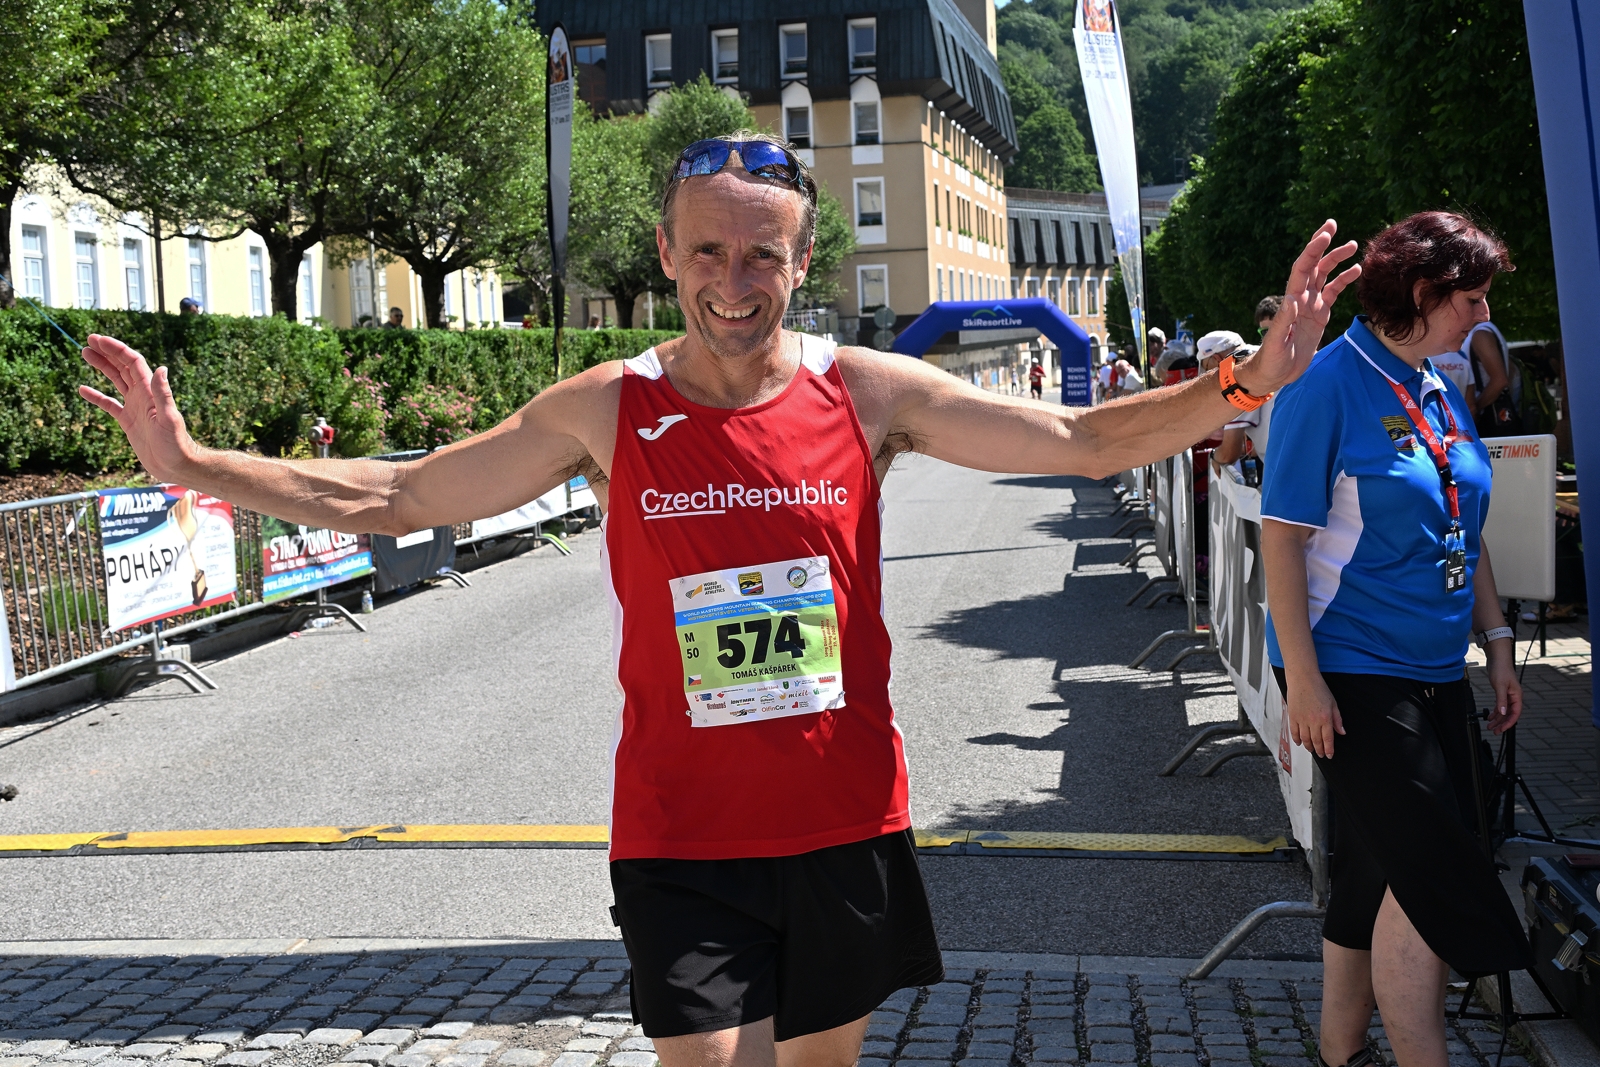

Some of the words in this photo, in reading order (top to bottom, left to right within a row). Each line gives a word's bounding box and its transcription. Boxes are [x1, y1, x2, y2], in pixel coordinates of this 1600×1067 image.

[962, 317, 1022, 327] SkiResortLive
[106, 544, 185, 587] POHÁRY
[724, 602, 750, 610] MOUNTAIN
[684, 632, 695, 643] M
[716, 615, 806, 669] 574
[686, 647, 700, 659] 50
[731, 666, 758, 680] TOMÁŠ
[759, 663, 797, 677] KAŠPÁREK
[761, 704, 786, 713] OlfinCar
